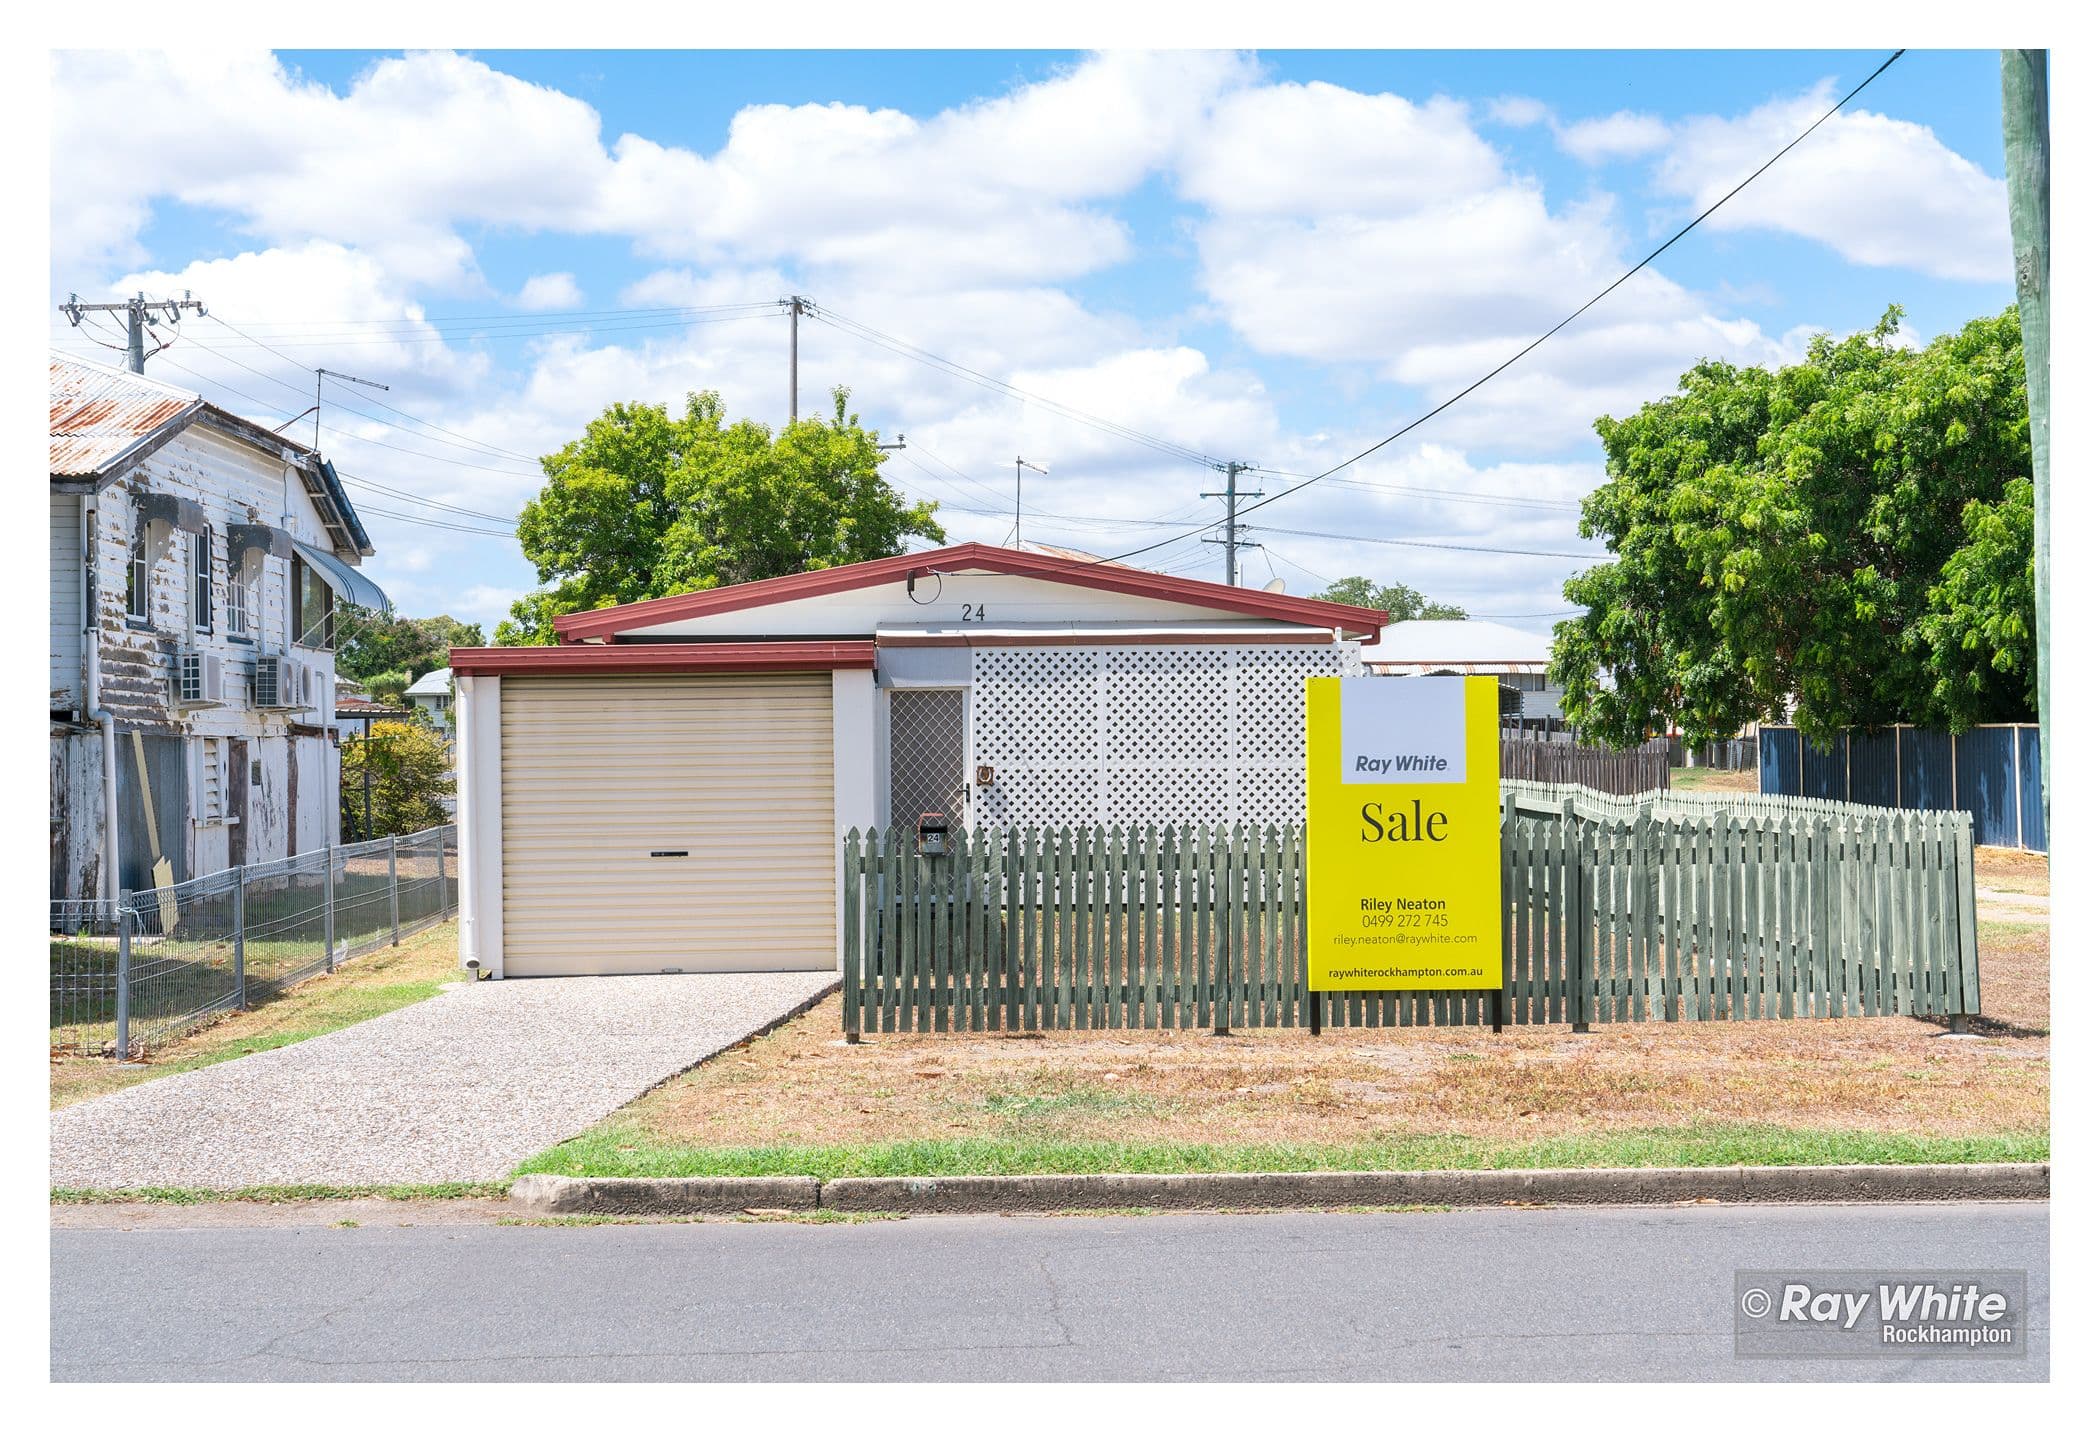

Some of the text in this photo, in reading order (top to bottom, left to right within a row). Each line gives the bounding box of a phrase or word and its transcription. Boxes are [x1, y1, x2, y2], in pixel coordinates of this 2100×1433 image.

[961, 603, 986, 622] 24
[1355, 755, 1448, 774] Ray White
[1361, 799, 1448, 842] Sale
[927, 833, 940, 844] 24
[1361, 898, 1446, 913] Riley Neaton
[1362, 914, 1448, 928] 0499 272 745
[1334, 933, 1477, 947] riley.neaton@raywhite.com
[1328, 966, 1483, 979] raywhiterockhampton.com.au
